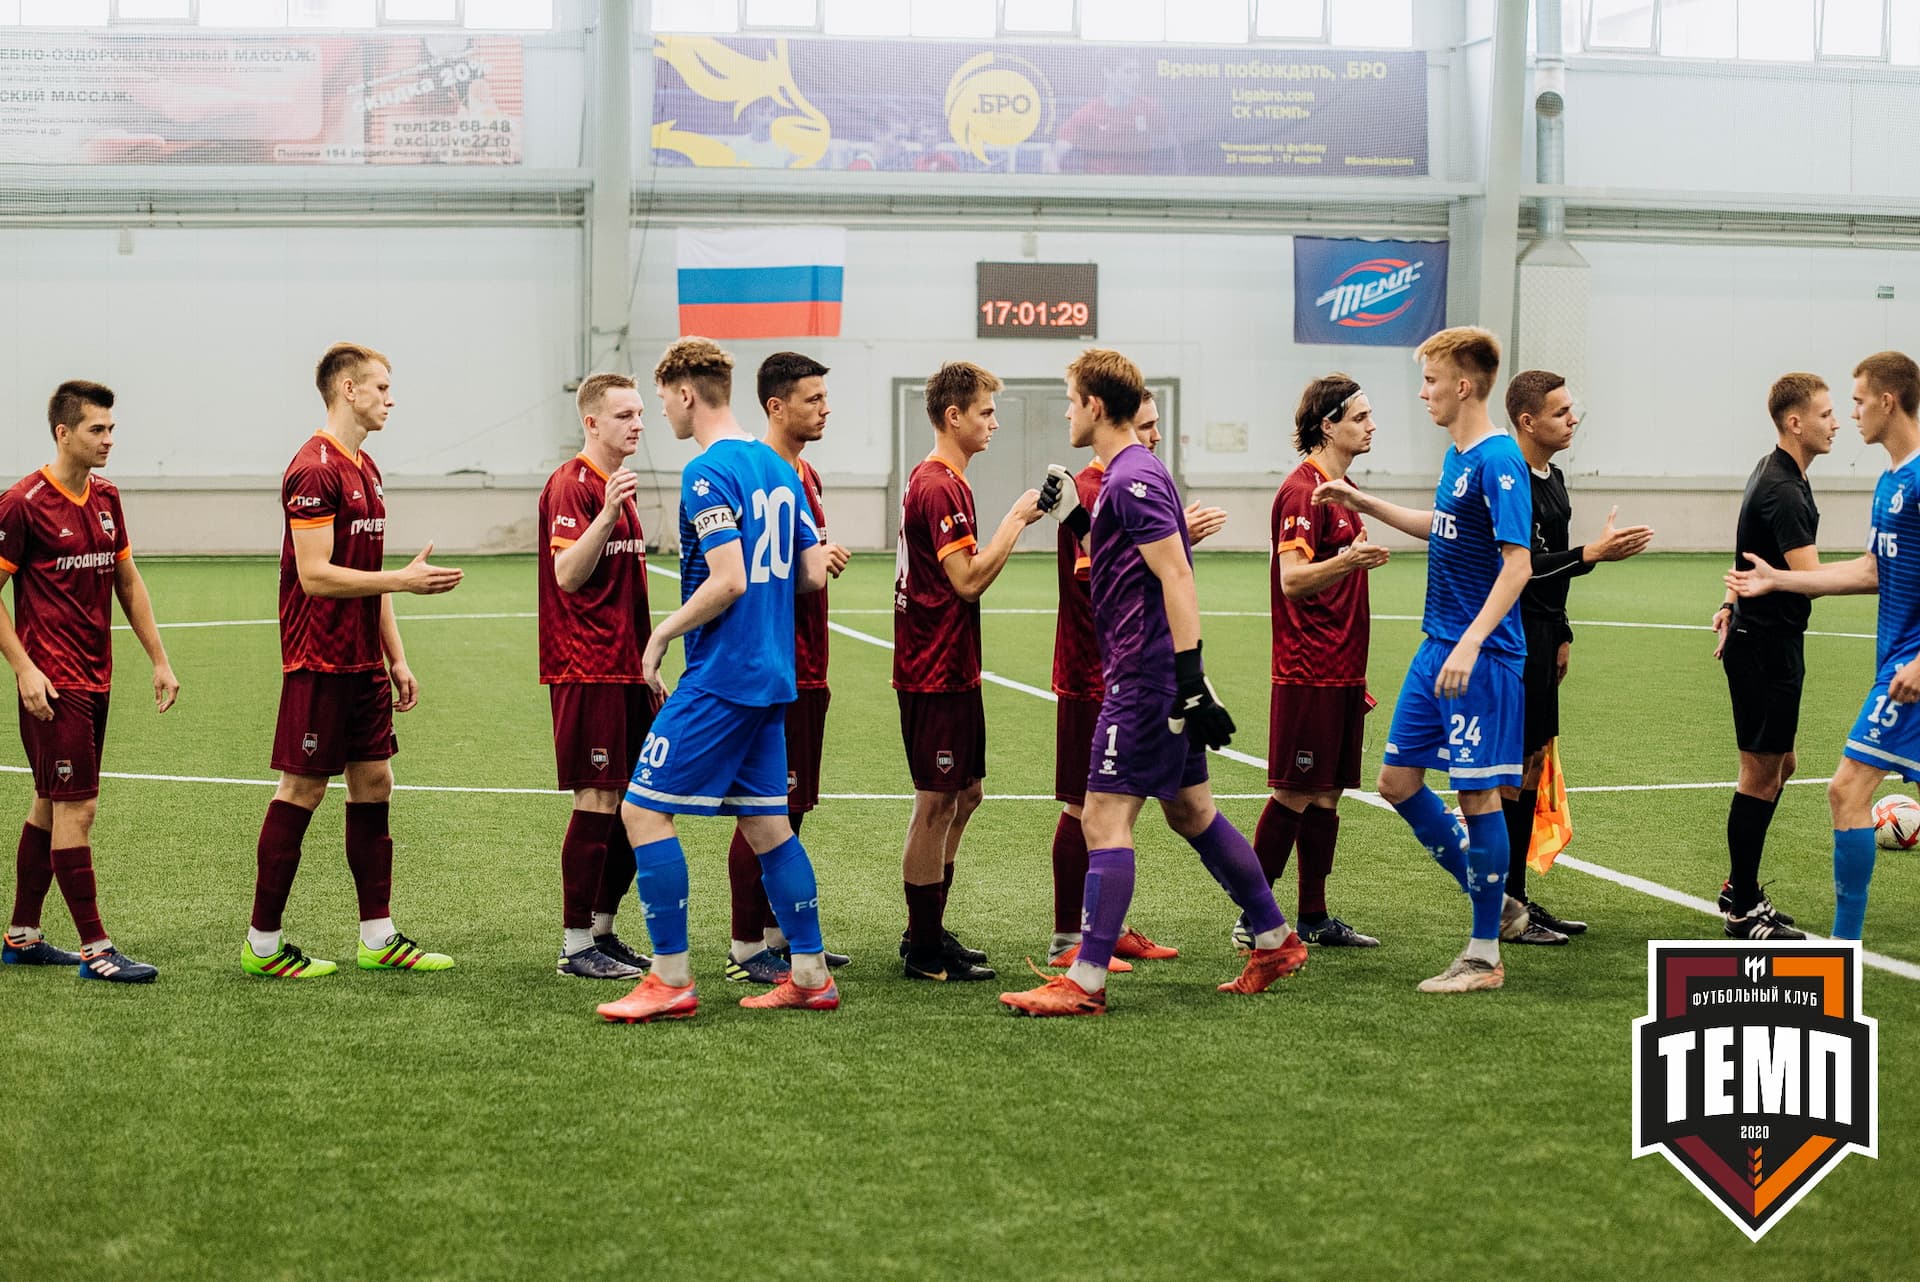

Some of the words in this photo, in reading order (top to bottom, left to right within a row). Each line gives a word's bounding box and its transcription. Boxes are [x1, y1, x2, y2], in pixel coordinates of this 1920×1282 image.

[1157, 60, 1220, 81] Время
[1224, 60, 1336, 81] побеждать,
[51, 90, 134, 103] МАССАЖ:
[971, 93, 1032, 115] .БРО
[1232, 107, 1252, 120] СК
[980, 299, 1089, 326] 17:01:29
[751, 485, 796, 584] 20
[1431, 509, 1458, 540] ВТБ
[1867, 694, 1904, 728] 15
[1104, 724, 1118, 757] 1
[1449, 714, 1482, 747] 24
[638, 731, 670, 768] 20
